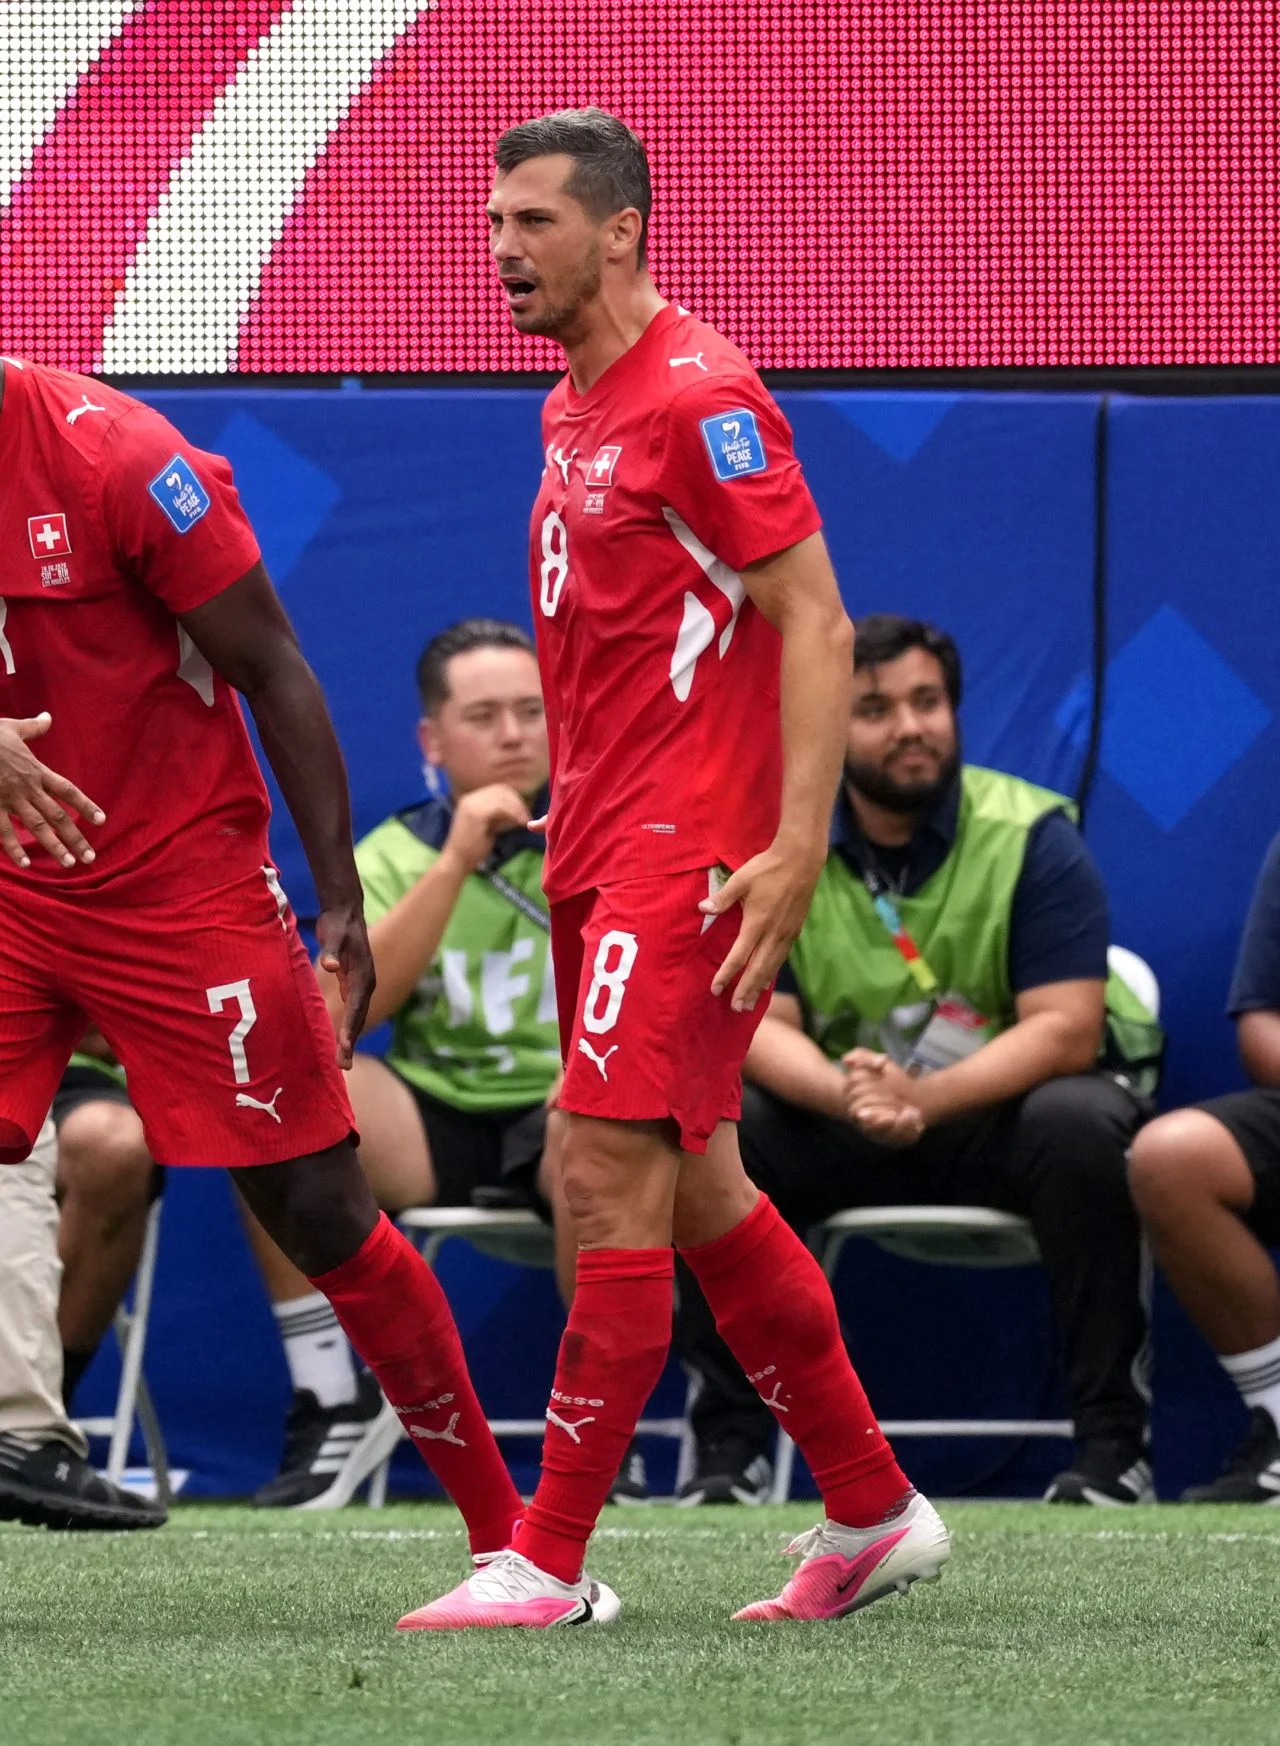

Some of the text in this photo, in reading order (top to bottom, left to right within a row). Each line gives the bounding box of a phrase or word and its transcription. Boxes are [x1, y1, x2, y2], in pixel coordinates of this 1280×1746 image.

[726, 449, 752, 465] PEACE
[180, 493, 200, 516] PEACE
[540, 511, 568, 617] 8
[583, 929, 638, 1035] 8
[206, 979, 257, 1084] 7
[550, 1388, 605, 1408] uisse
